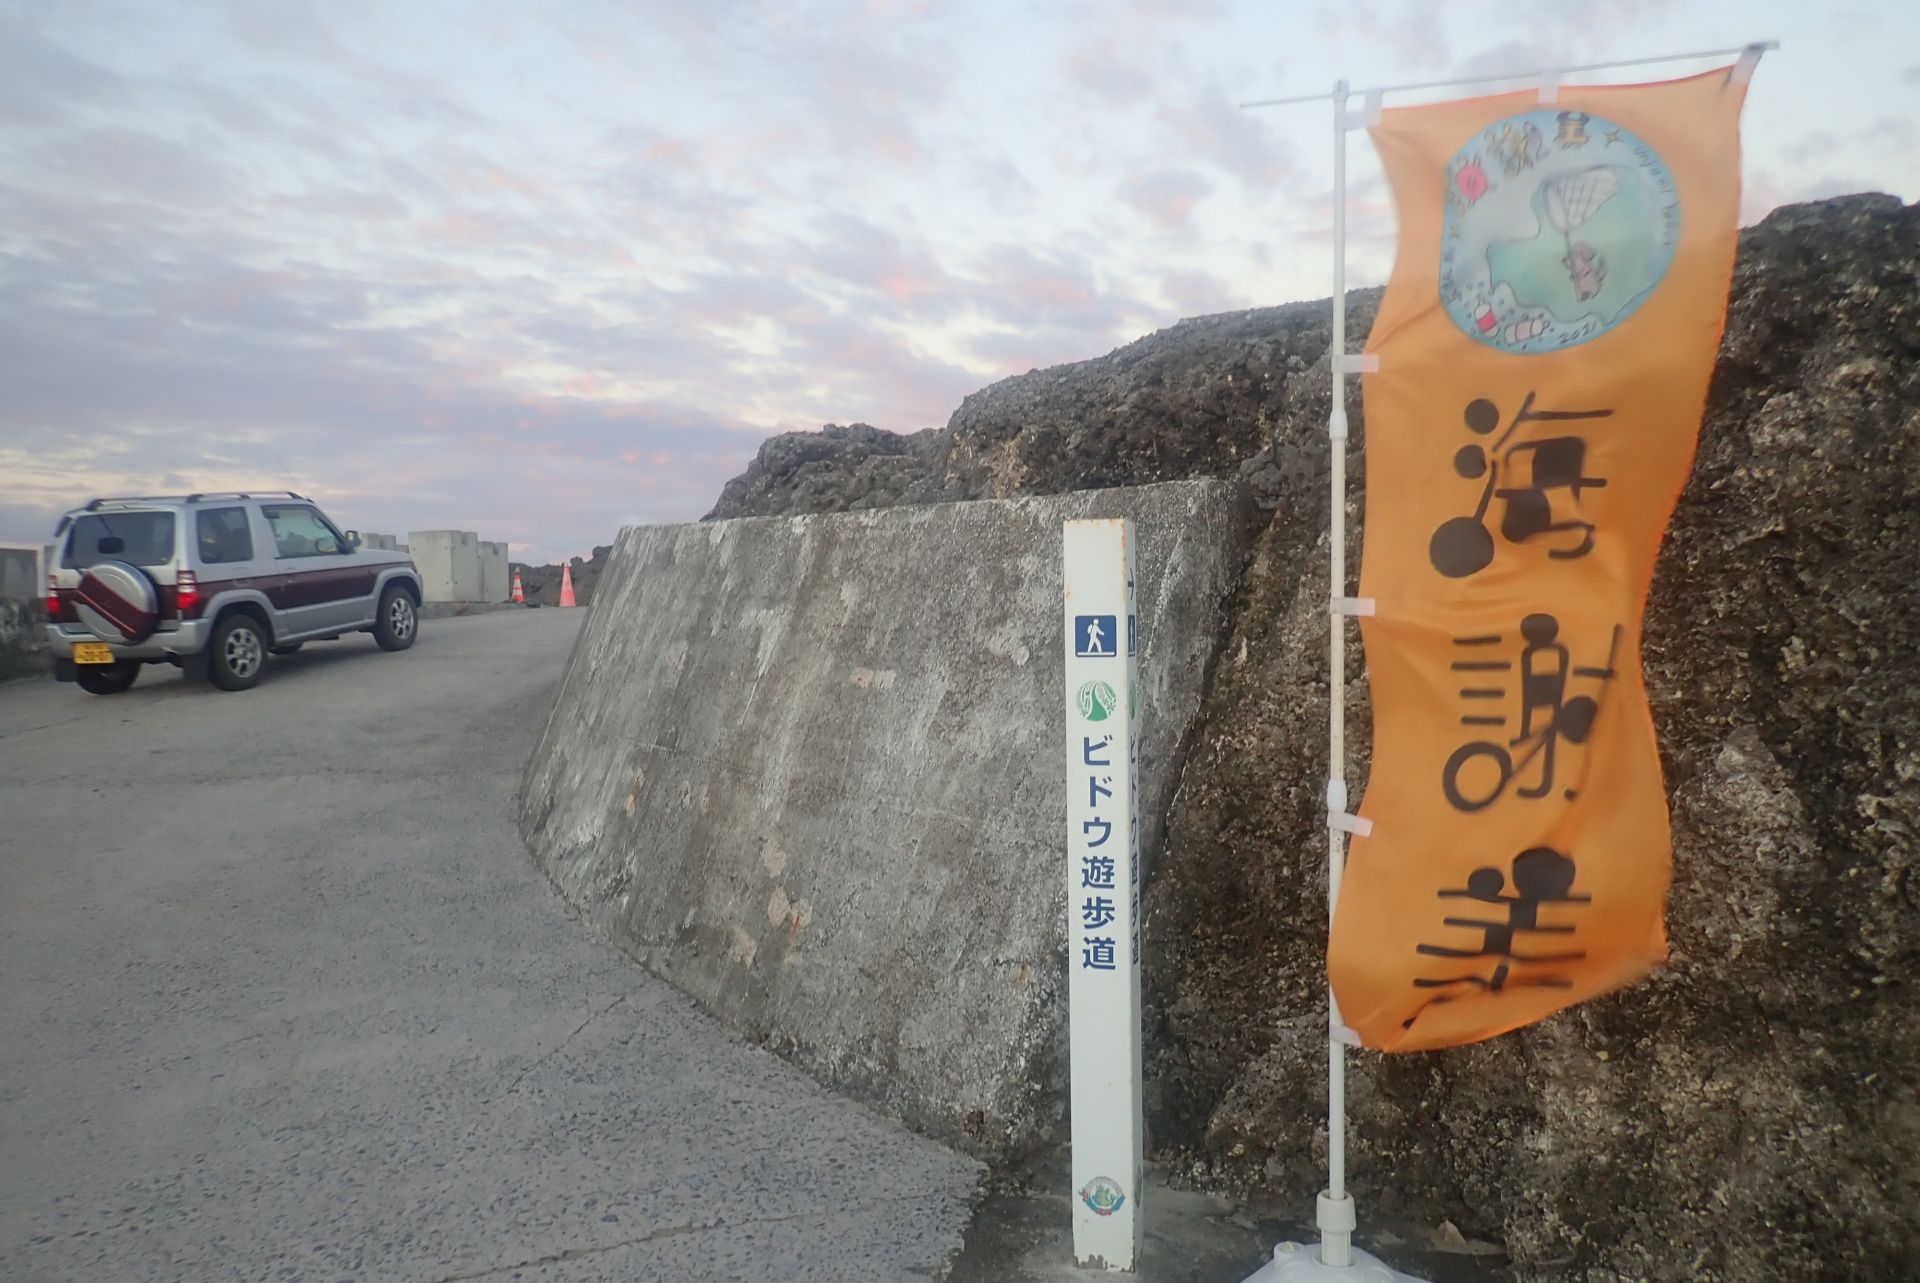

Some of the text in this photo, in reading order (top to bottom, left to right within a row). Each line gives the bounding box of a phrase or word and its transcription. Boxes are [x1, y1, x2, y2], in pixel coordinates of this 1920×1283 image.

[1558, 319, 1597, 345] 2021
[1081, 734, 1117, 971] ビドウ遊歩道
